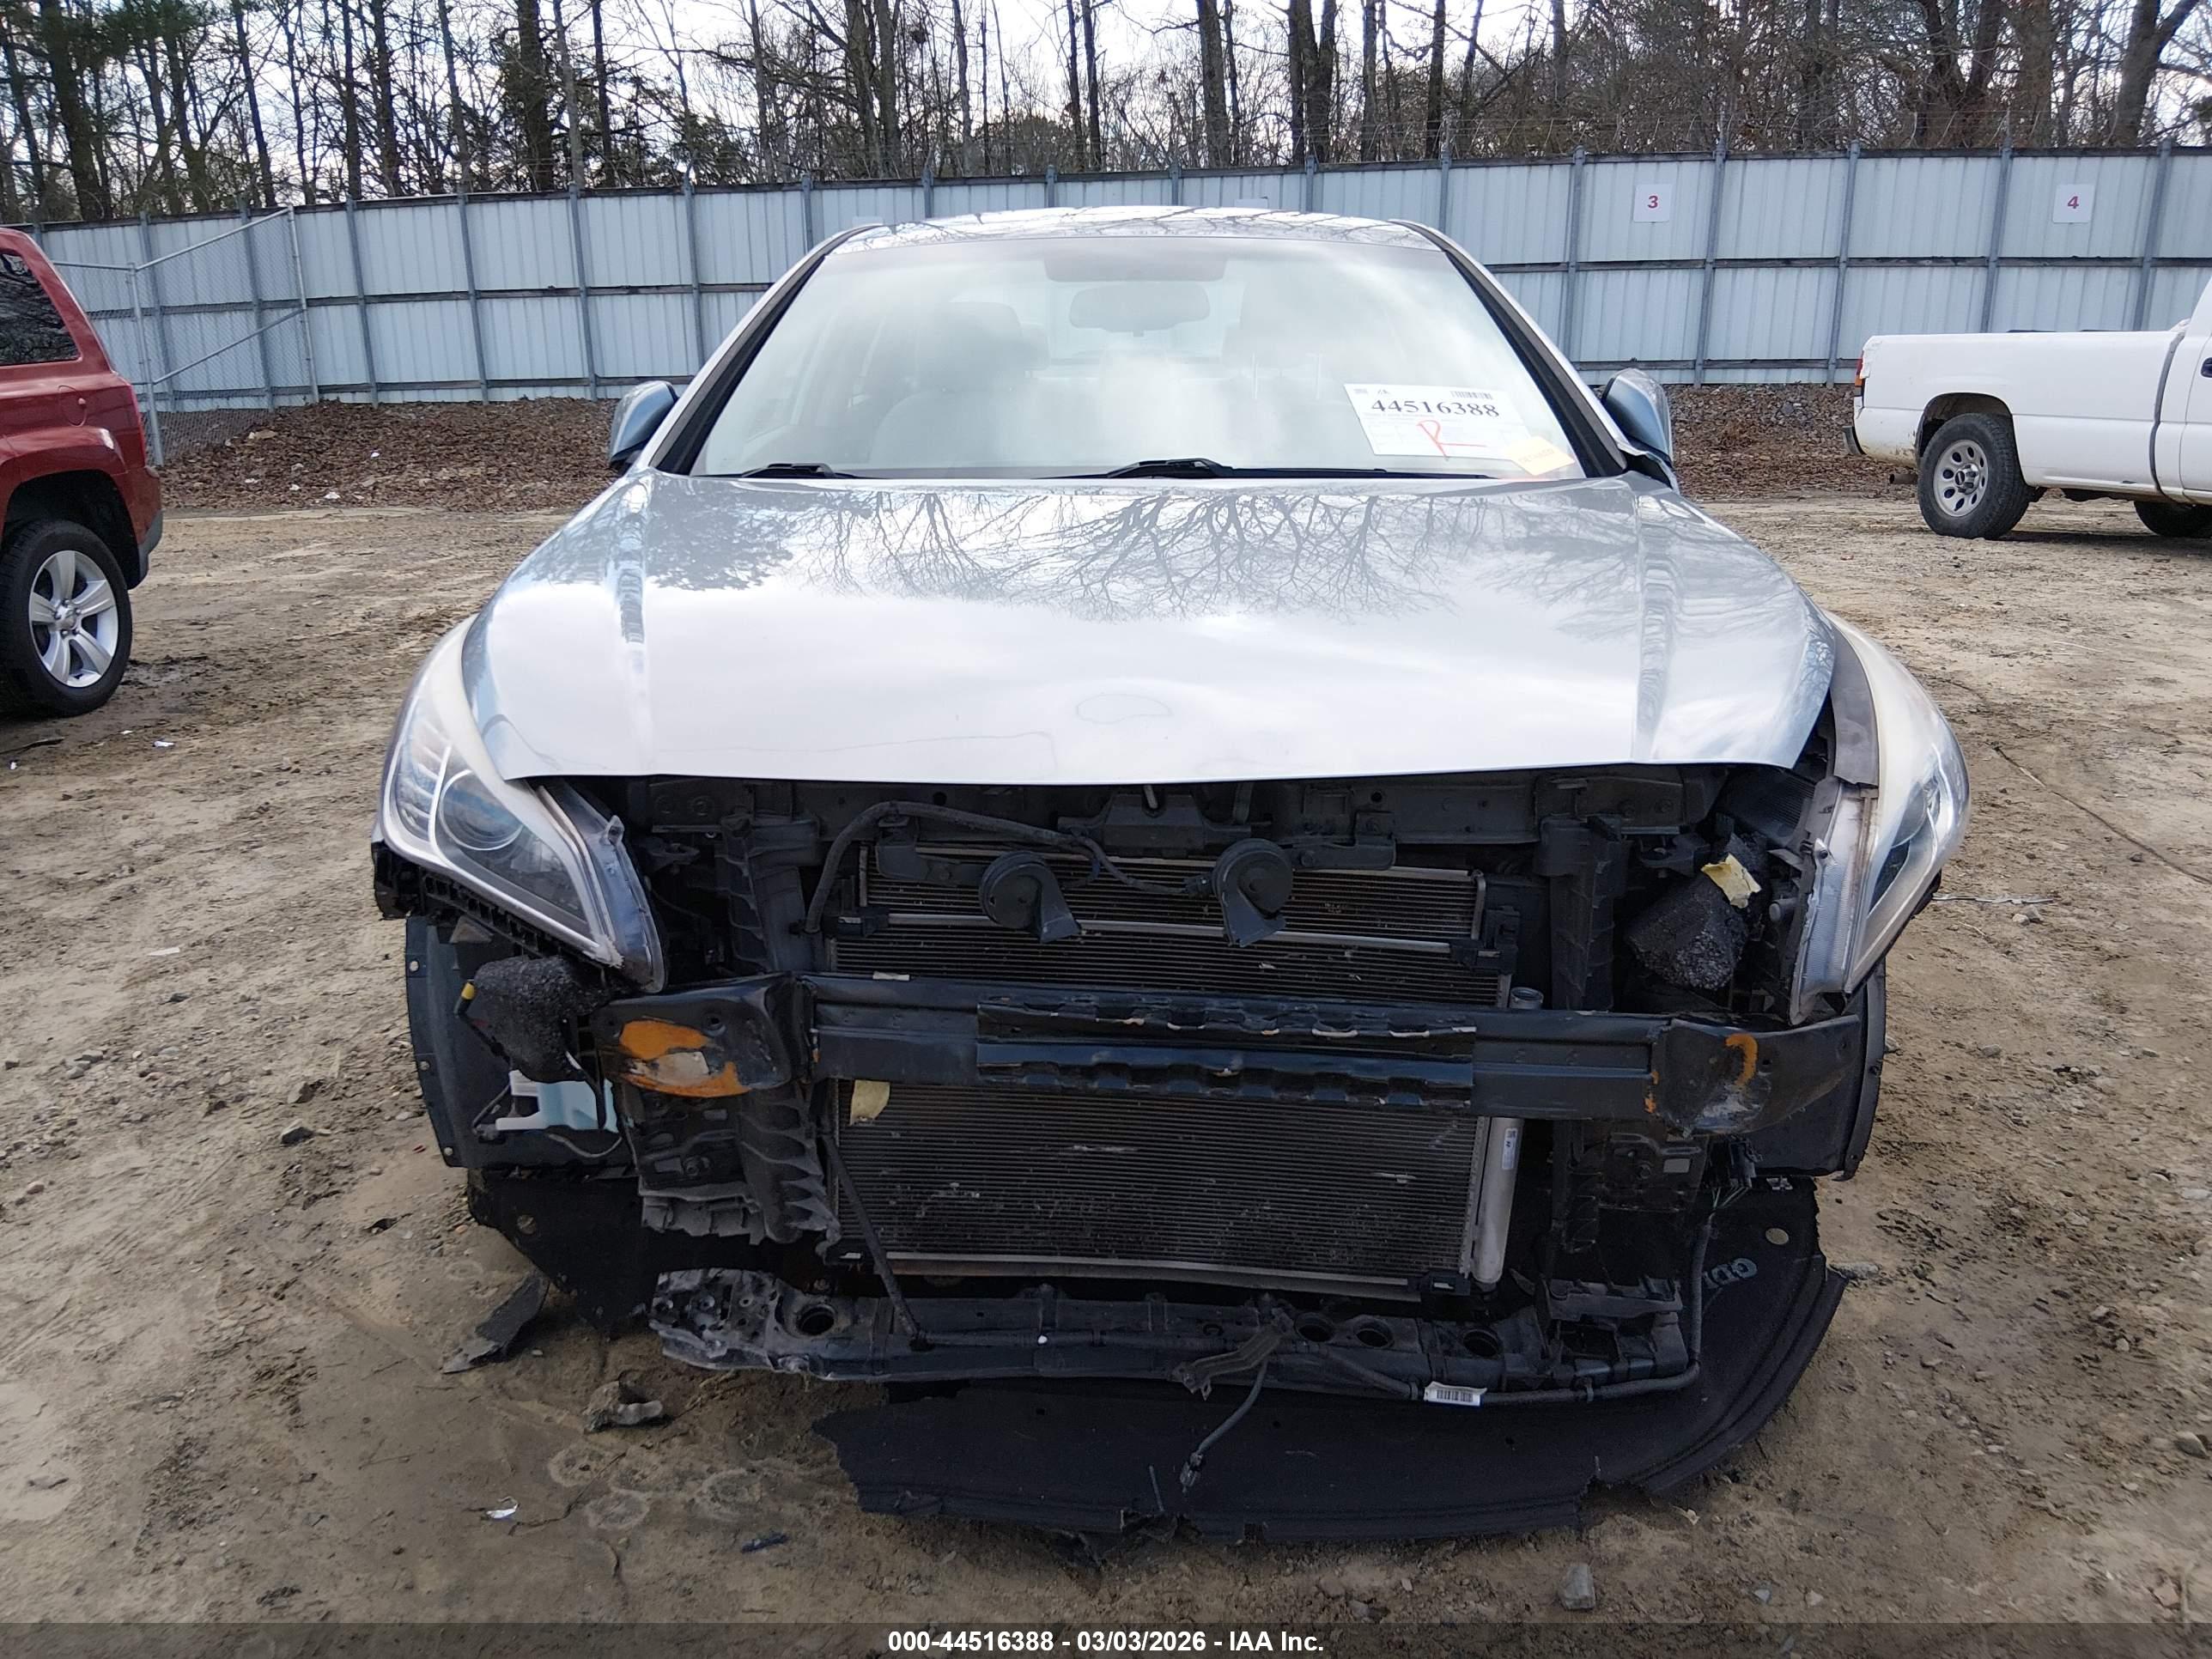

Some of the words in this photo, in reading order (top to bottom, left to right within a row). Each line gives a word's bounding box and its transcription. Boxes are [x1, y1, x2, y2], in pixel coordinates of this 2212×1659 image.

[1647, 195, 1659, 209] 3
[2067, 196, 2080, 210] 4
[1371, 399, 1500, 418] 44516388
